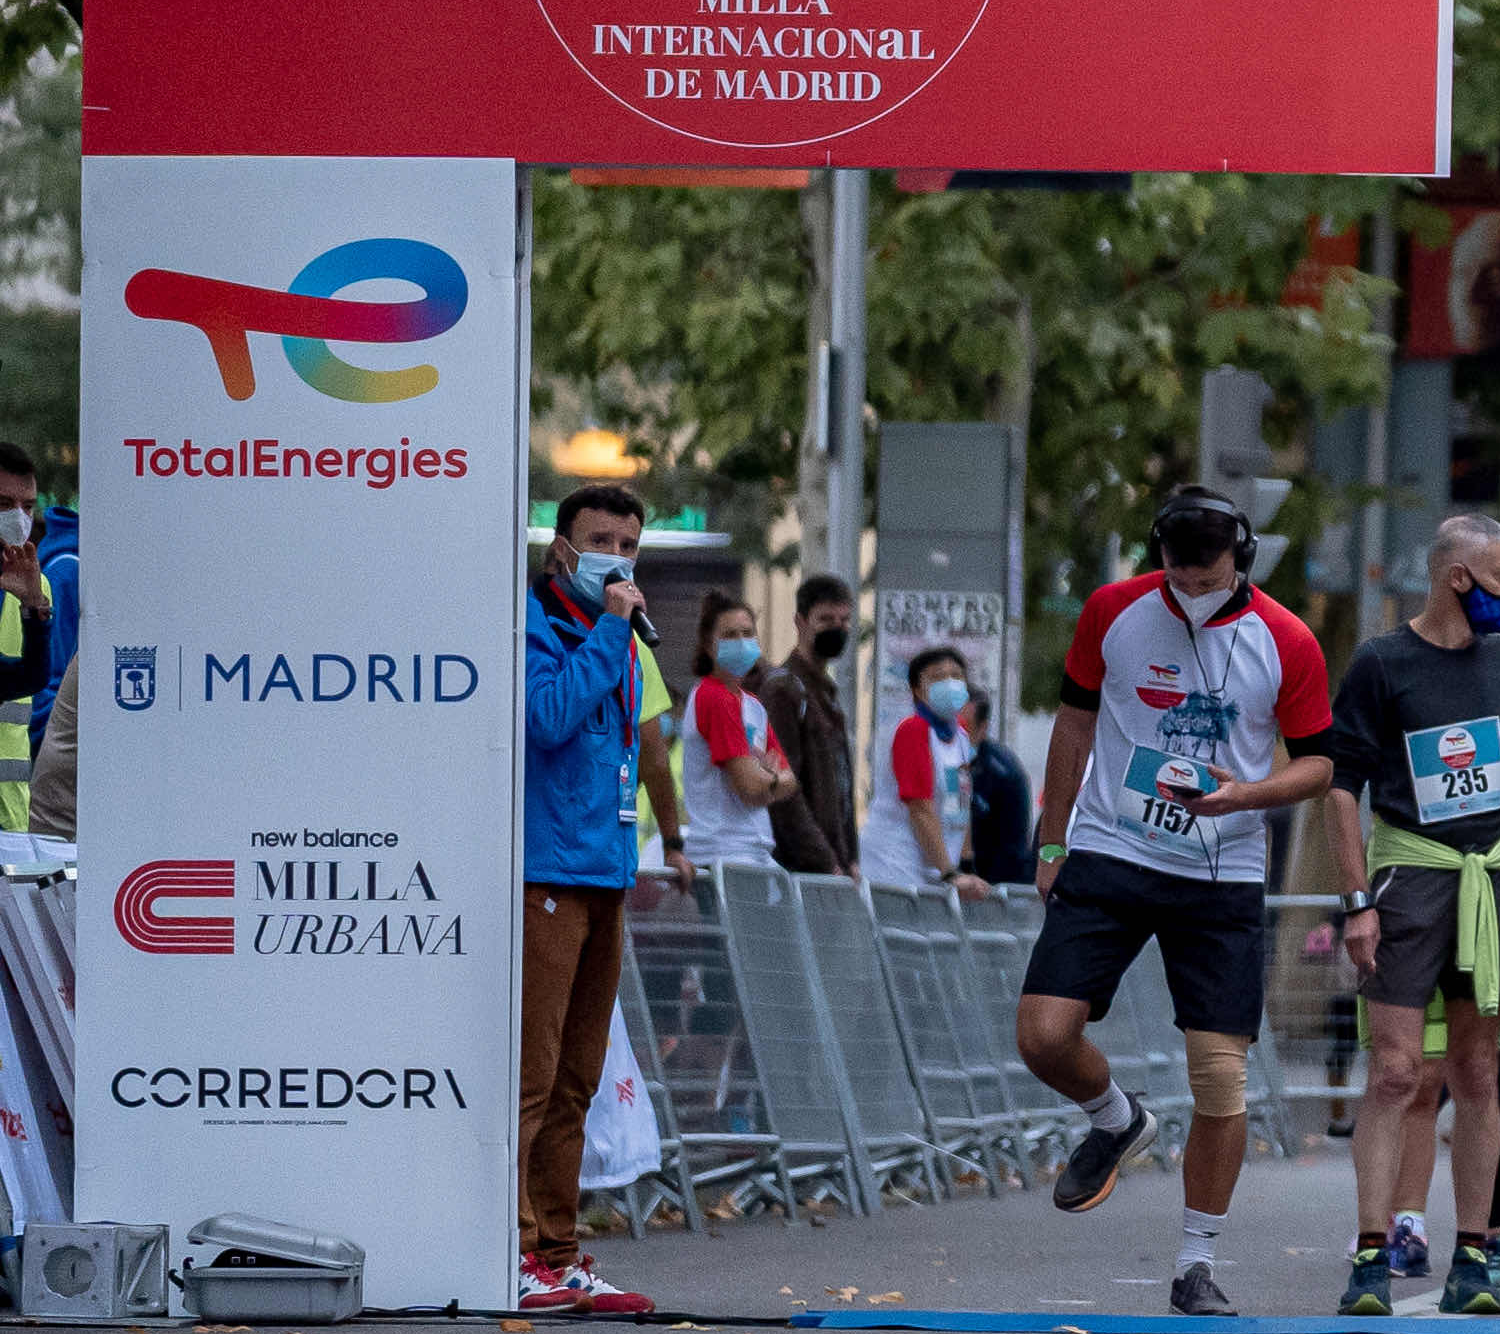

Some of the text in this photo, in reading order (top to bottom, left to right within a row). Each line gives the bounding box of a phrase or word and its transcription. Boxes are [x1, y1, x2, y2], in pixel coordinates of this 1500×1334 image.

[644, 68, 882, 102] DE MADRID
[123, 437, 469, 490] TotalEnergies
[204, 653, 480, 703] MADRID
[1442, 767, 1489, 800] 235
[1142, 797, 1197, 836] 1157
[250, 827, 400, 848] new balance
[252, 859, 442, 901] MILLA
[252, 914, 468, 956] URBANA
